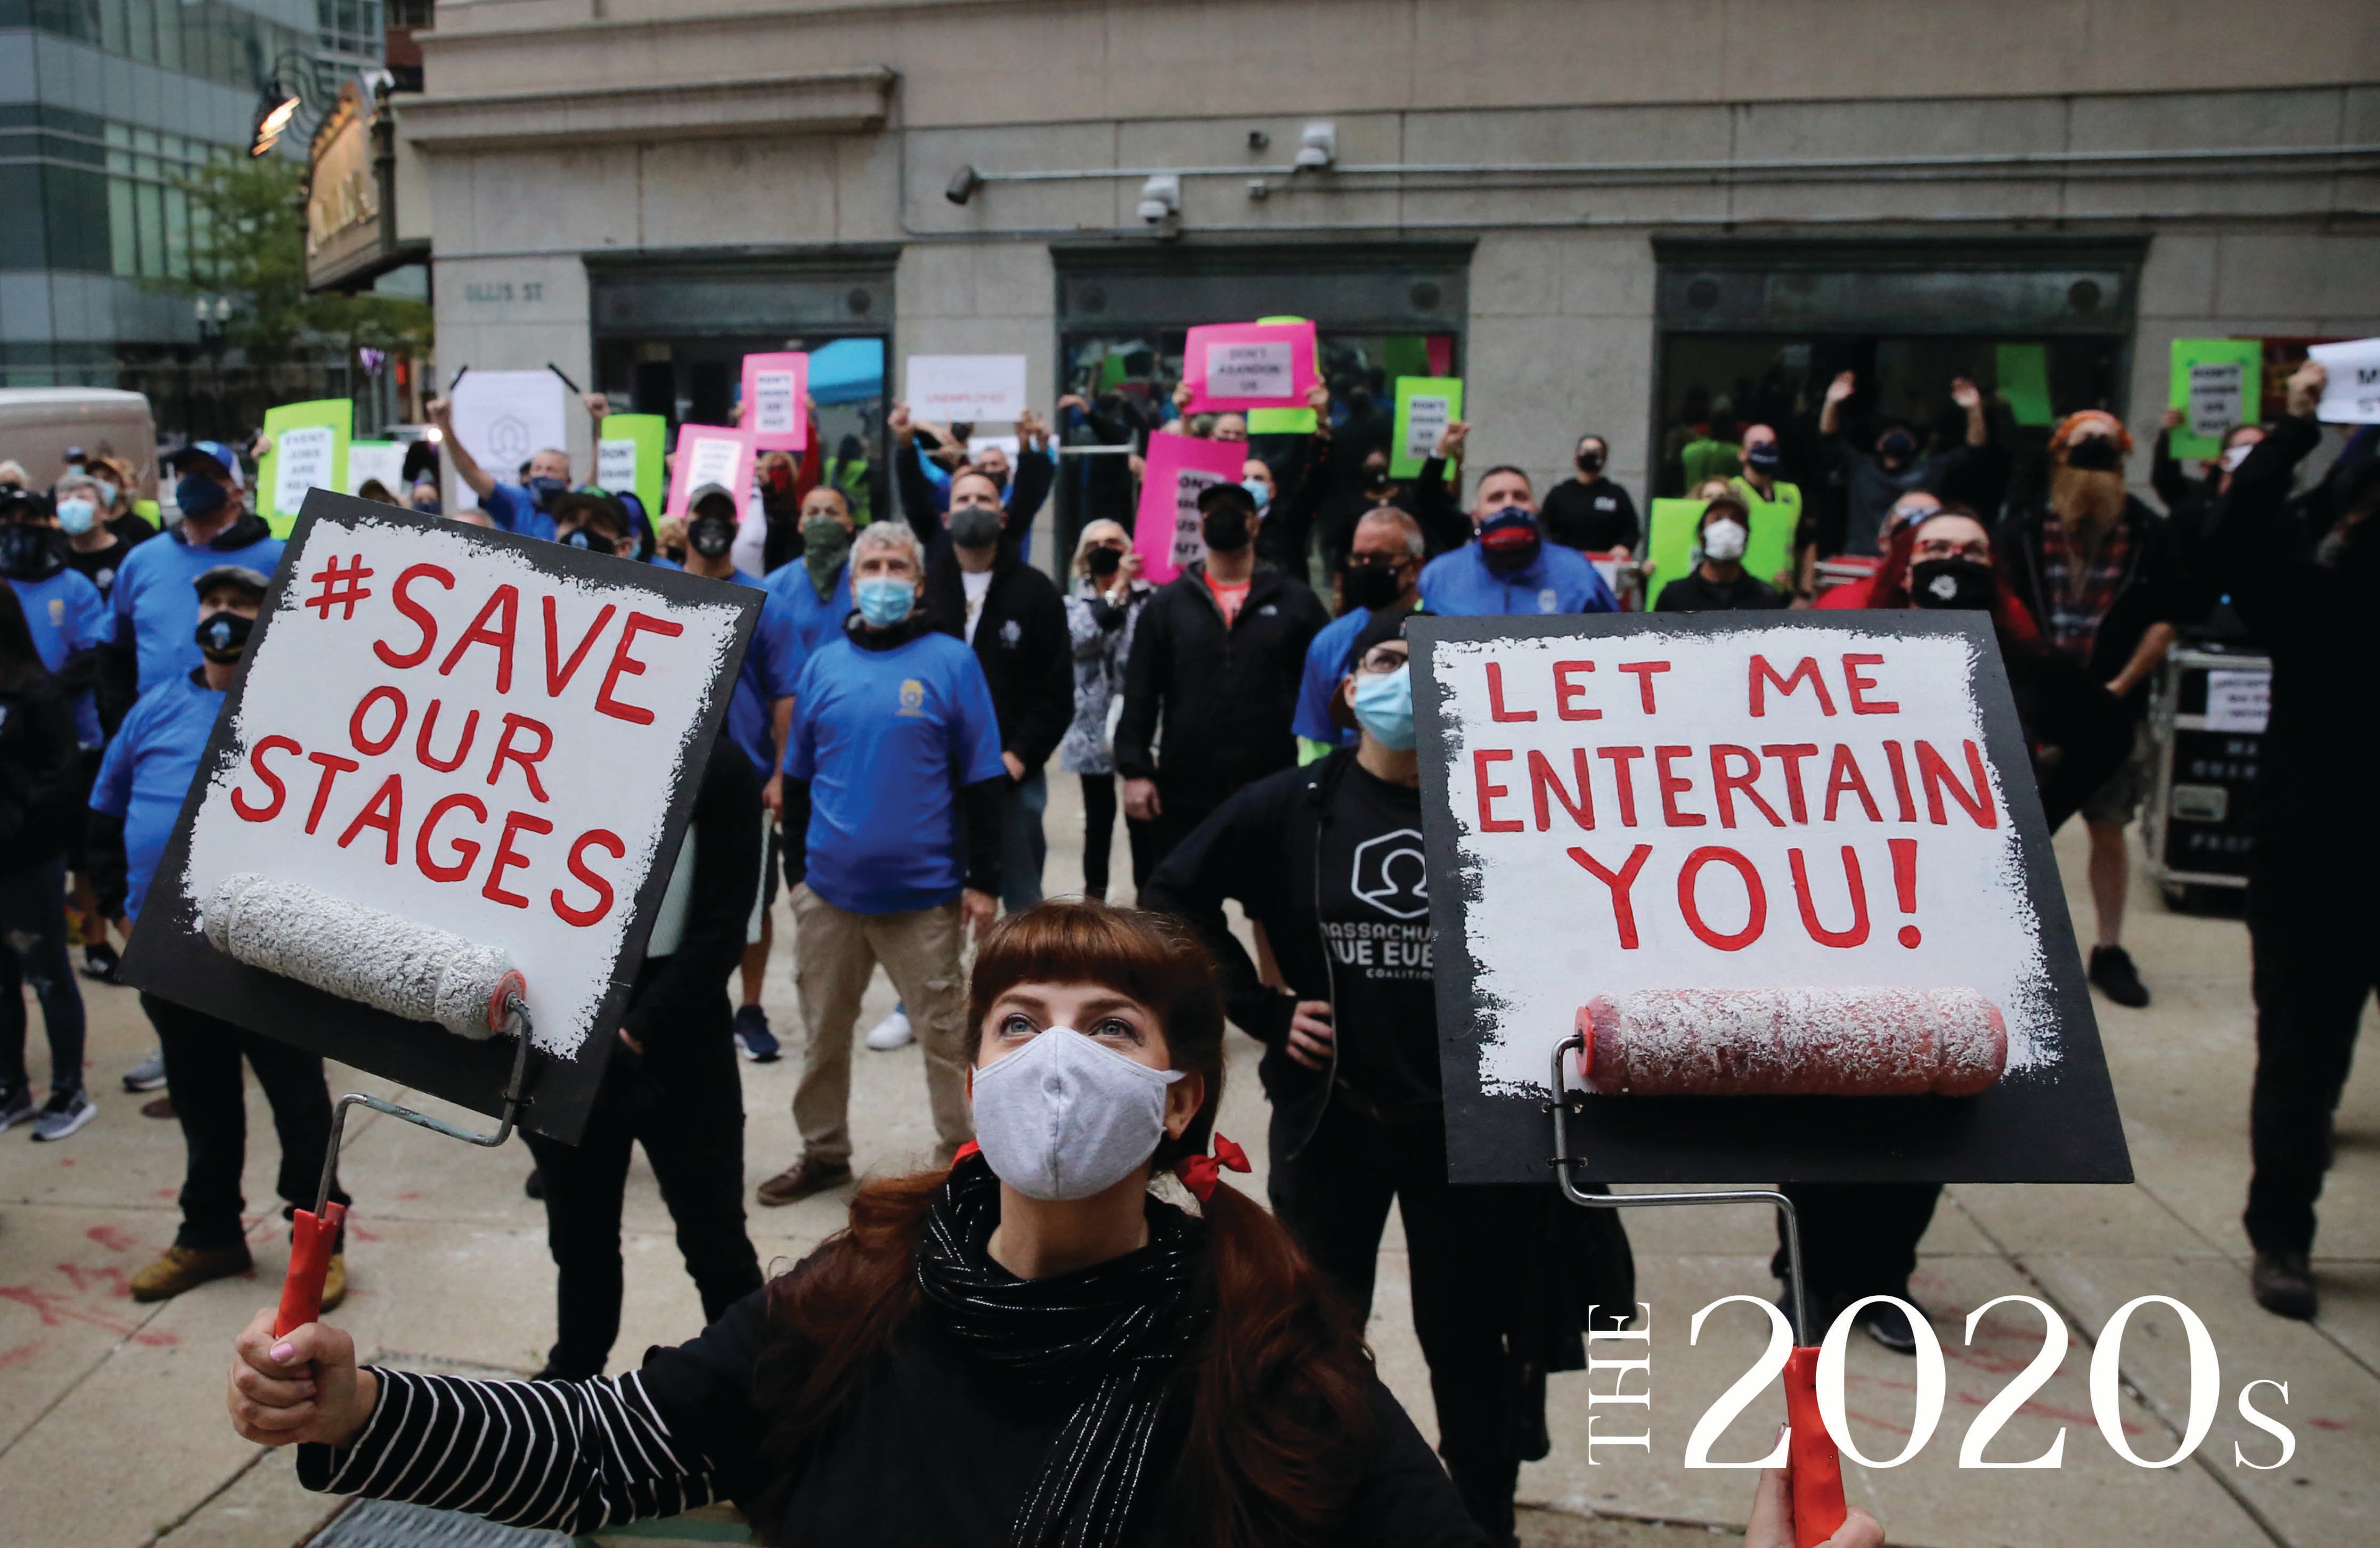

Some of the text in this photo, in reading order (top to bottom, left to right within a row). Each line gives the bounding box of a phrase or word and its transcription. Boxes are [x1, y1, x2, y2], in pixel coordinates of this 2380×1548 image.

[304, 553, 684, 726] #SAVE
[1484, 653, 1900, 723] LET ME
[349, 685, 553, 803] OUR
[1473, 739, 1998, 833] ENTERTAIN
[230, 734, 626, 928] STAGES
[1566, 838, 1923, 951] YOU!
